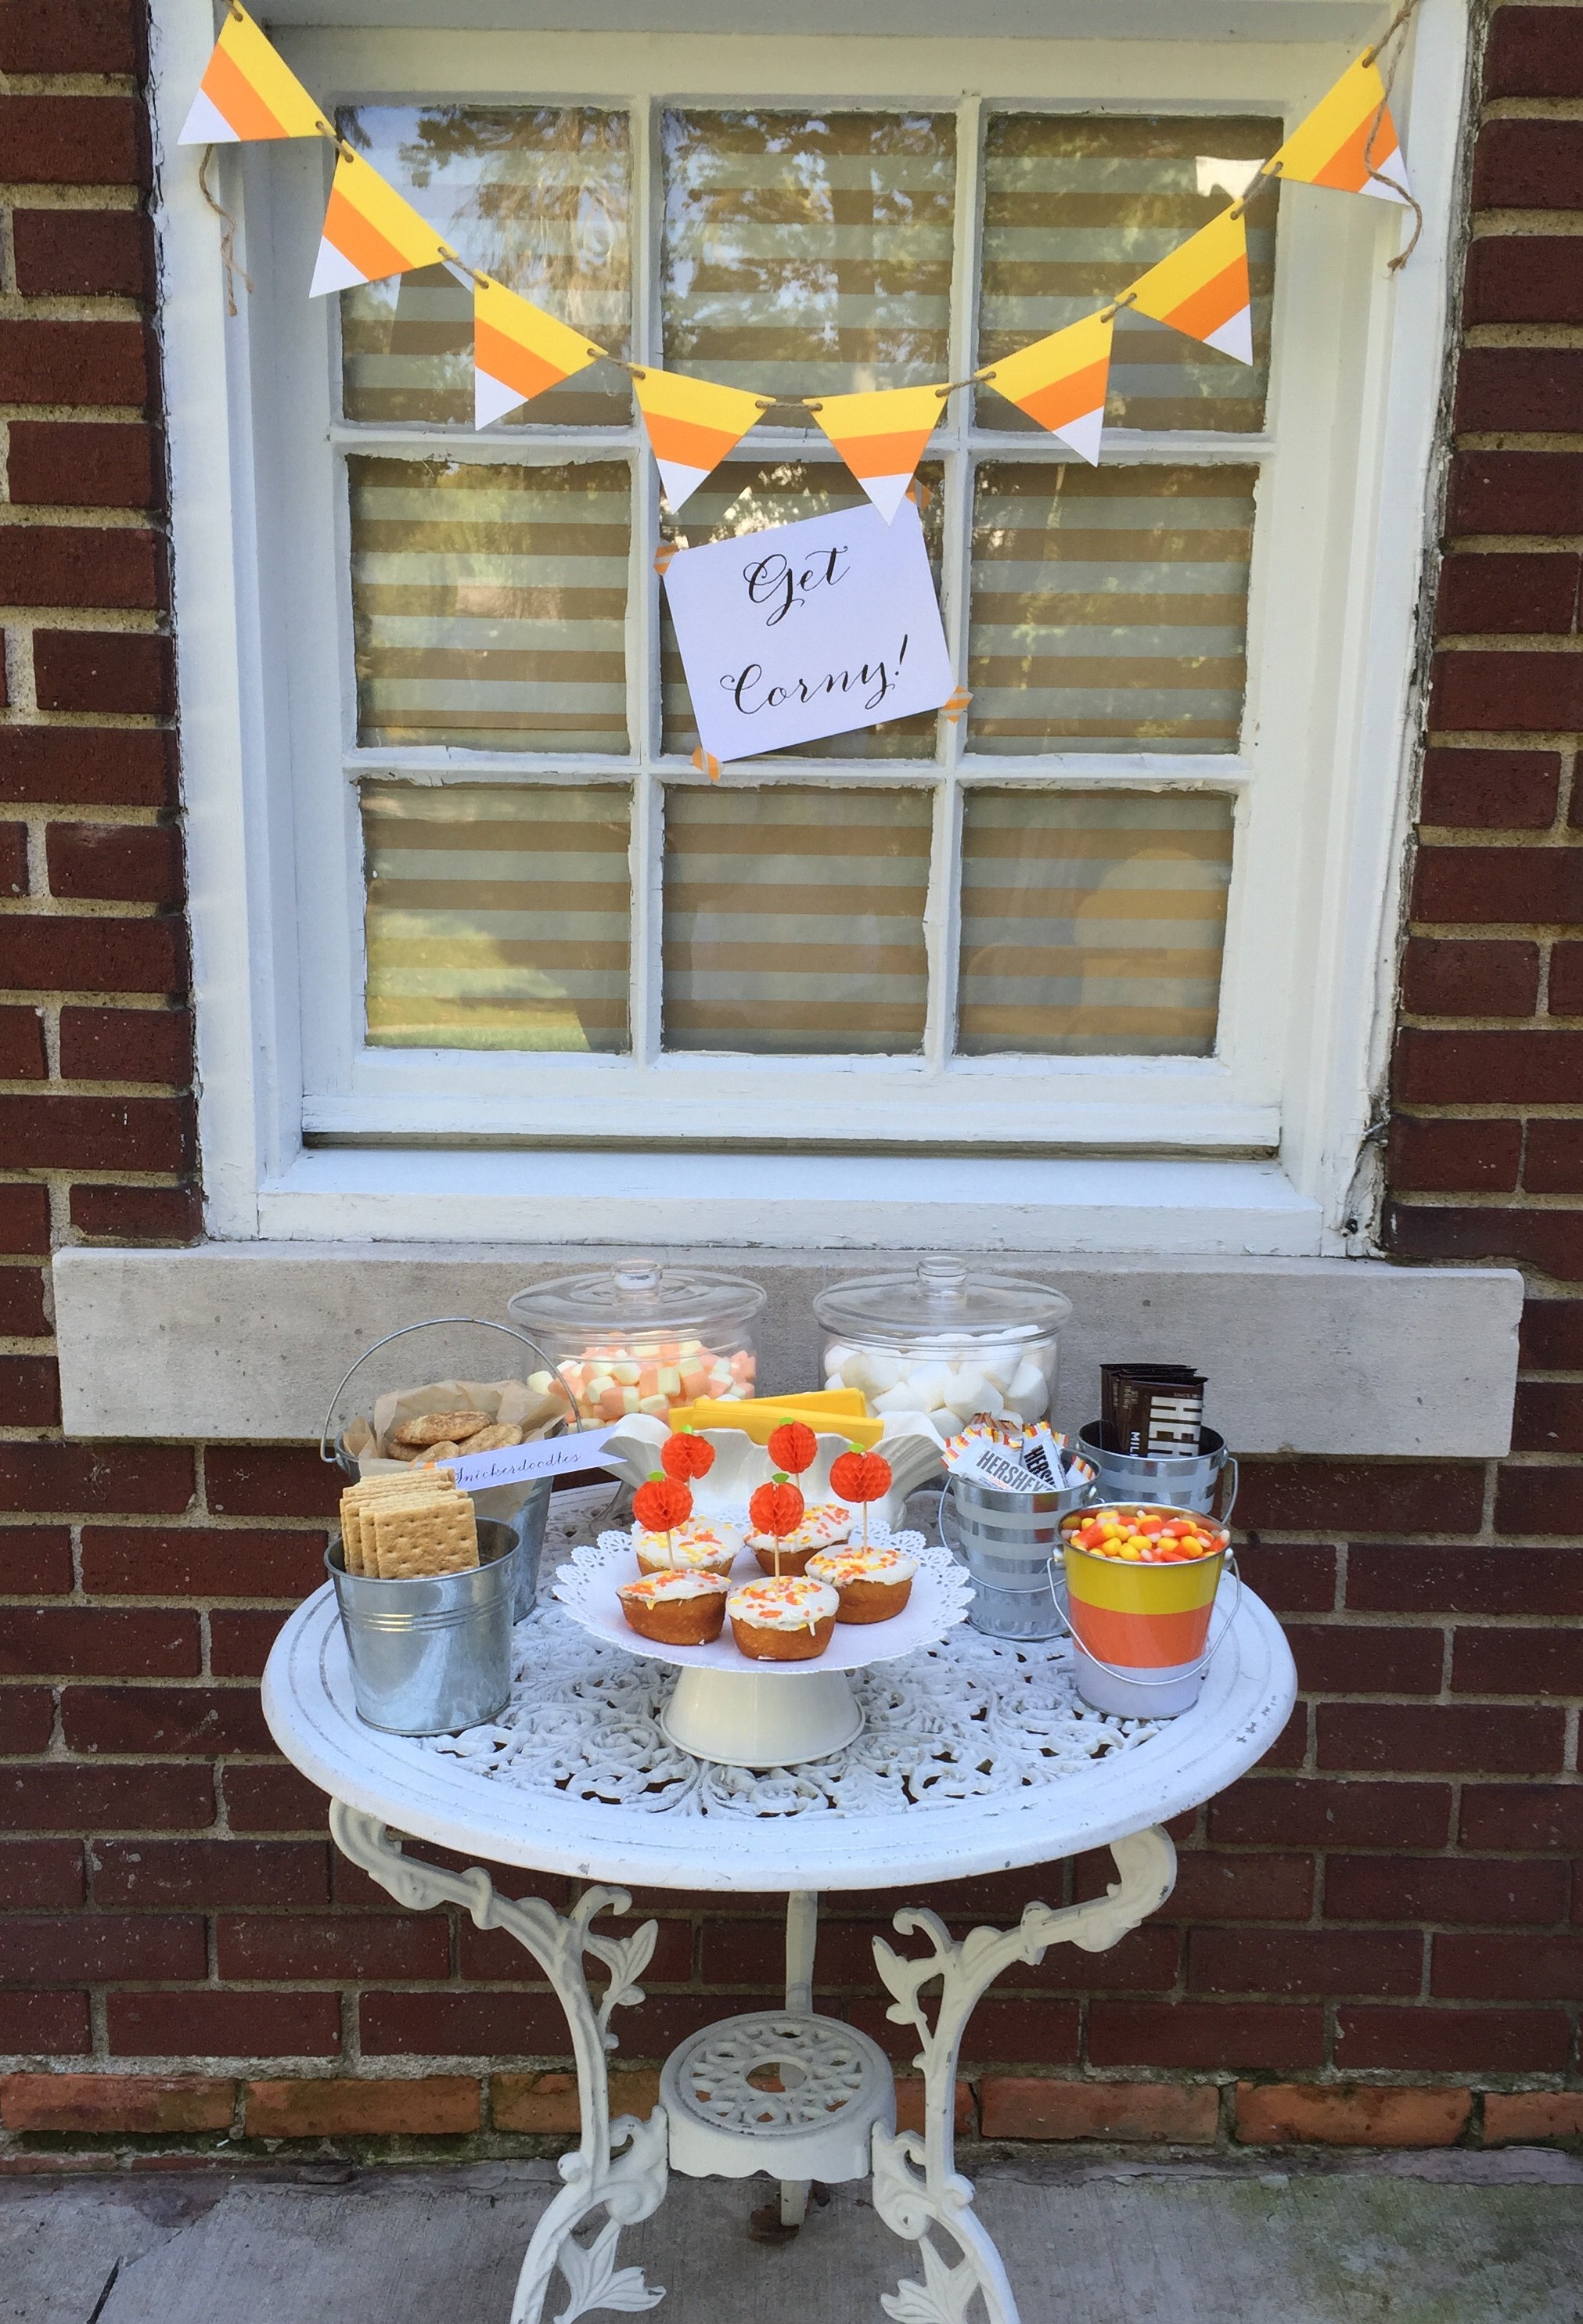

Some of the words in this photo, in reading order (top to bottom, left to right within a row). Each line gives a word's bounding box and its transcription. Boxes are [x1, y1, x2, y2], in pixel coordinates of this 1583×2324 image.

[743, 545, 851, 627] Get
[719, 633, 908, 715] Corny!
[455, 1451, 581, 1484] Snickerdoodles
[1024, 1444, 1056, 1488] HERS
